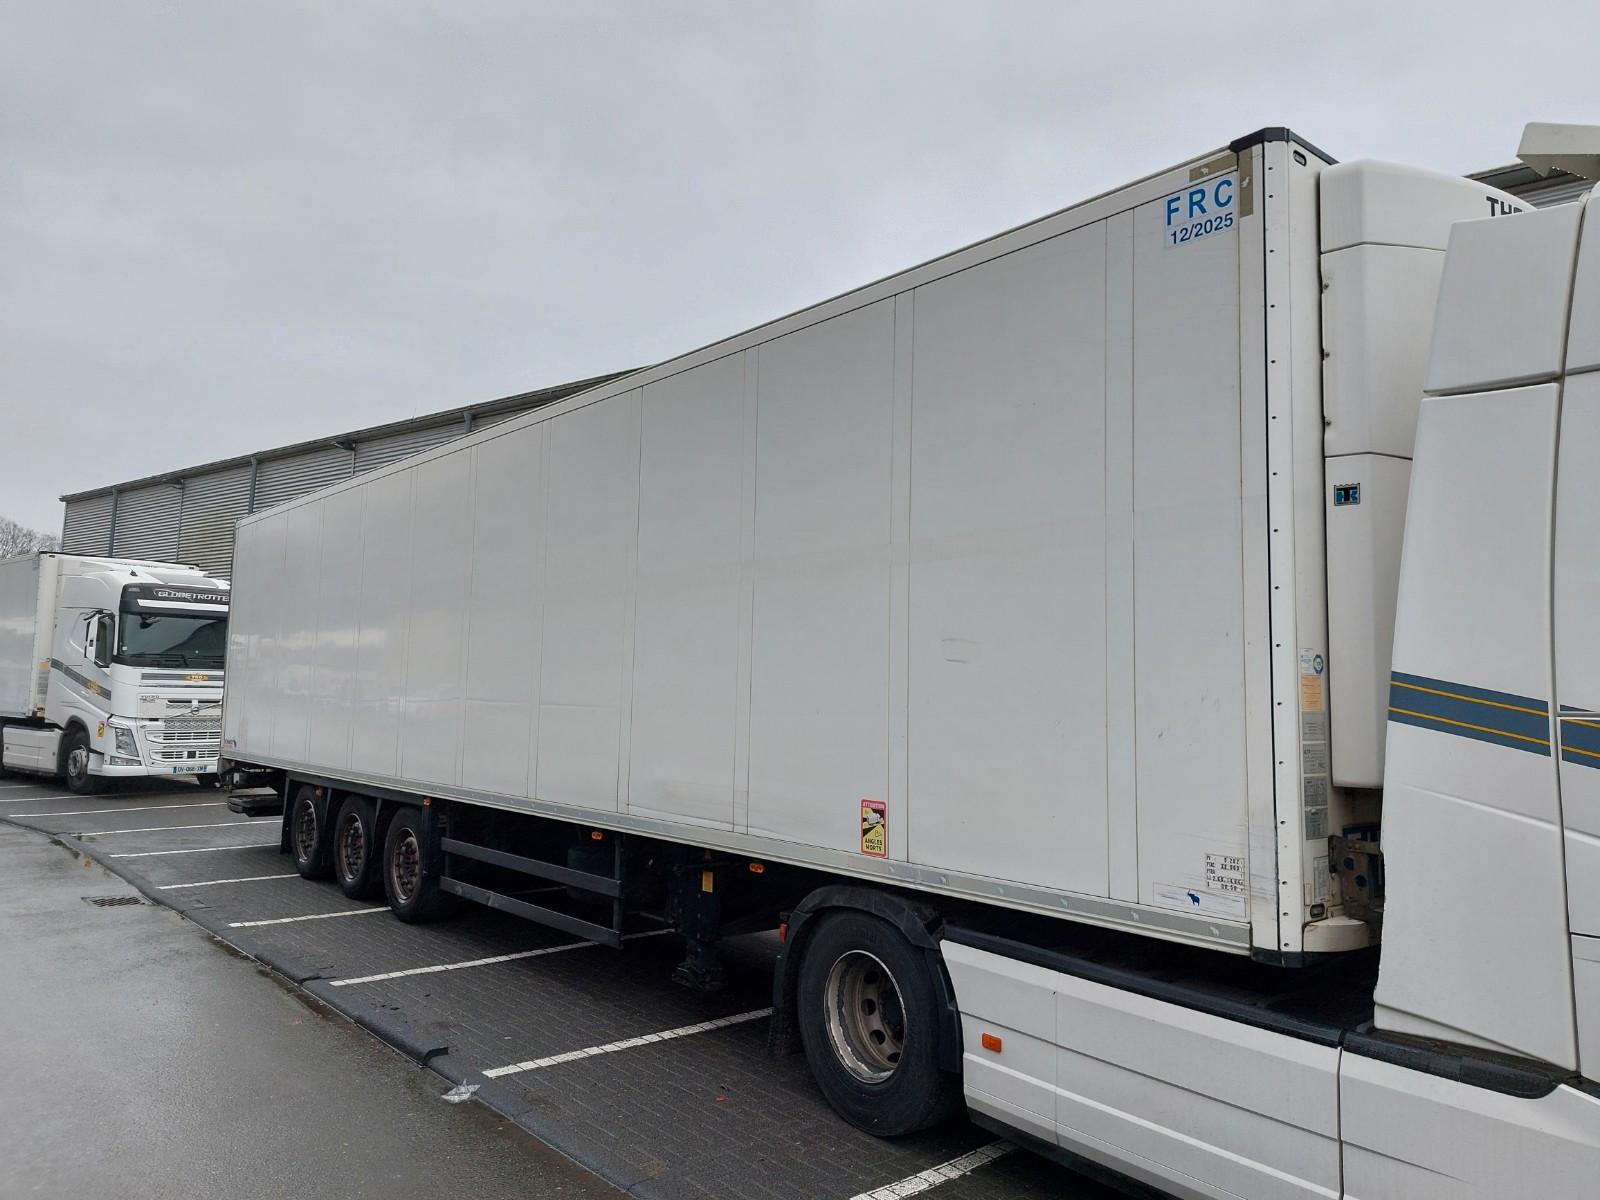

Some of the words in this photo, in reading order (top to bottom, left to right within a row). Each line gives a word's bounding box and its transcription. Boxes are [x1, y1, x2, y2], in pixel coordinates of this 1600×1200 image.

[1166, 179, 1233, 226] FRC
[1170, 212, 1234, 245] 12/2025
[158, 591, 229, 602] GLOBETROTTE
[865, 838, 882, 846] ANGLES
[866, 844, 882, 852] MORTS
